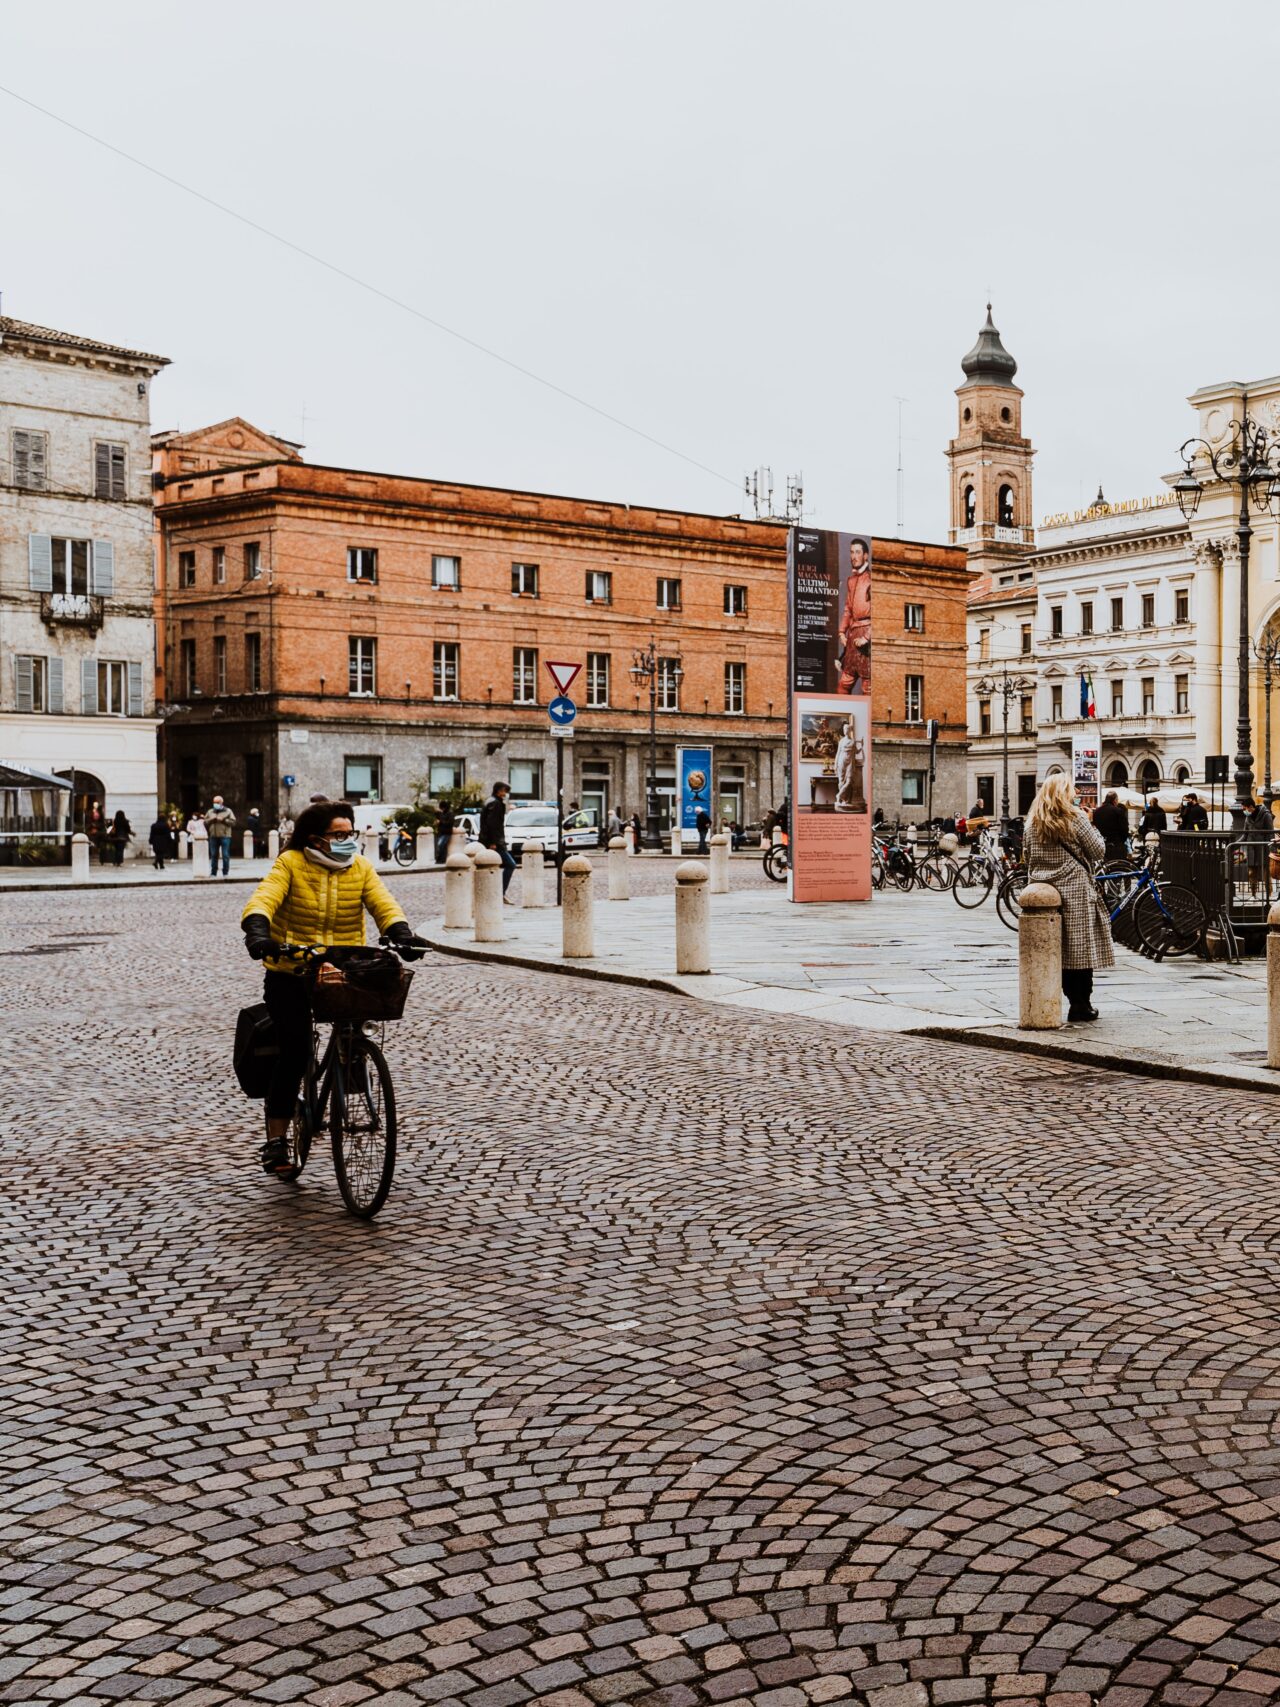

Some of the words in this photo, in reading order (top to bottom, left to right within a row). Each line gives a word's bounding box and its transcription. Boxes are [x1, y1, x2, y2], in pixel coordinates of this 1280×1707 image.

[1043, 512, 1070, 527] CASSA
[1074, 510, 1083, 521] DI
[1086, 498, 1139, 518] RISPARMIO
[1142, 497, 1152, 507] DI
[797, 563, 817, 572] LUIGI
[797, 571, 832, 581] MAGNANI
[797, 586, 839, 595] ROMANTICO
